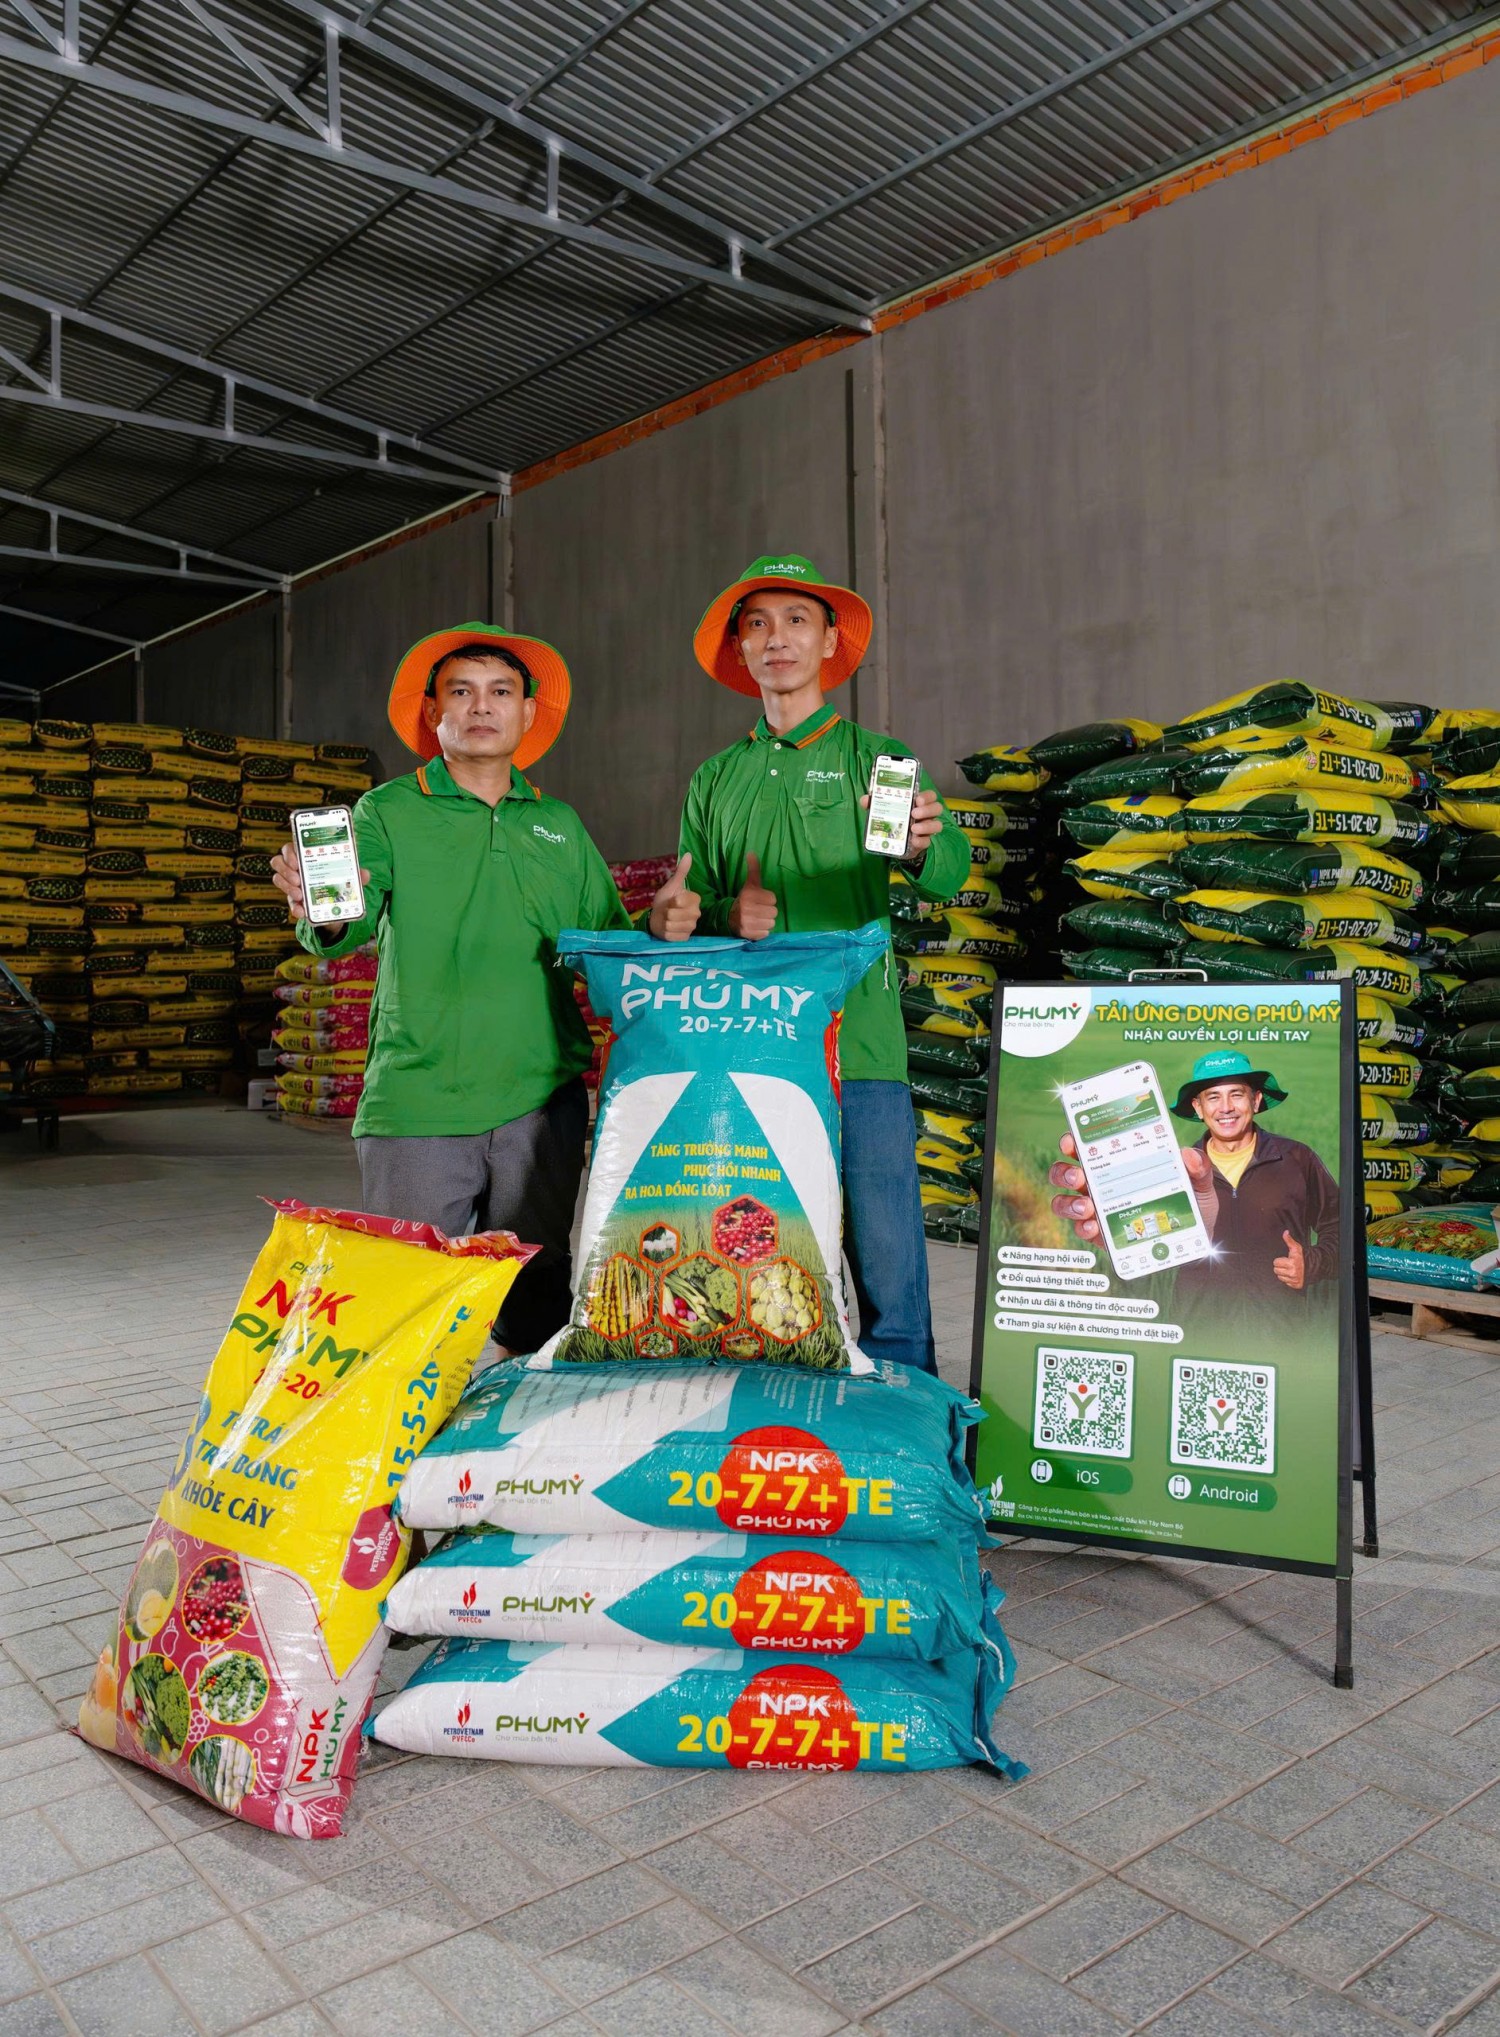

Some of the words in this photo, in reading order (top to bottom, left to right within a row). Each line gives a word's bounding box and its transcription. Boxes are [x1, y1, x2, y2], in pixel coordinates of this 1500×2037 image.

[764, 563, 806, 574] PHUMY
[807, 770, 846, 780] PHUMY
[1321, 753, 1381, 781] 20-20-15+TE
[1315, 812, 1379, 834] 20-20-15+TE
[533, 825, 566, 843] PHUMY
[1405, 829, 1418, 840] NPK
[1317, 919, 1379, 939] 20-20-15+TE
[621, 963, 744, 987] NPK
[621, 983, 731, 1019] PHÚ
[741, 984, 815, 1017] MỸ
[1004, 1003, 1082, 1020] PHUMY
[1095, 999, 1127, 1022] TẢI
[1133, 1000, 1180, 1022] ỨNG
[1186, 1005, 1249, 1026] DỤNG
[1256, 1000, 1303, 1022] PHÚ
[1309, 1001, 1342, 1022] MỸ
[679, 1015, 798, 1041] 20-7-7+TE
[1124, 1027, 1163, 1043] NHẬN
[1167, 1026, 1215, 1042] QUYỀN
[1219, 1029, 1243, 1044] LỢI
[1247, 1026, 1279, 1041] LIỀN
[1284, 1030, 1310, 1041] TAY
[1205, 1057, 1235, 1067] PHUMY
[1360, 1065, 1409, 1085] 0-20-15+TE
[651, 1142, 680, 1157] TĂNG
[734, 1144, 768, 1160] MẠNH
[717, 1162, 738, 1177] HỒI
[741, 1167, 781, 1182] NHANH
[625, 1187, 637, 1199] RA
[640, 1184, 663, 1197] HOA
[665, 1180, 699, 1196] ĐỒNG
[1009, 1251, 1032, 1262] Nâng
[1033, 1253, 1055, 1265] hạng
[1056, 1254, 1071, 1264] hội
[1072, 1256, 1090, 1264] viên
[1008, 1272, 1023, 1282] Đổi
[1025, 1276, 1041, 1285] quà
[1043, 1276, 1063, 1287] tặng
[1064, 1277, 1084, 1287] thiết
[1085, 1279, 1105, 1291] thực
[1007, 1296, 1029, 1307] Nhận
[1044, 1298, 1057, 1307] đãi
[1058, 1299, 1065, 1307] &
[1067, 1300, 1093, 1311] thông
[1094, 1302, 1106, 1310] tin
[1108, 1303, 1125, 1313] độc
[1127, 1304, 1154, 1316] quyền
[1006, 1318, 1030, 1328] Tham
[1031, 1321, 1045, 1330] gia
[1046, 1322, 1057, 1332] sự
[1058, 1322, 1077, 1333] kiện
[1087, 1325, 1119, 1336] chương
[1121, 1326, 1142, 1337] trình
[1161, 1329, 1179, 1341] biệt
[750, 1450, 819, 1474] NPK
[495, 1473, 584, 1495] PHUMY
[1076, 1469, 1100, 1485] iOS
[668, 1471, 893, 1515] 20-7-7+TE
[1199, 1484, 1258, 1504] Android
[181, 1480, 226, 1513] KHỎE
[228, 1498, 275, 1528] CÂY
[736, 1514, 792, 1529] PHÚ
[1018, 1504, 1033, 1512] Công
[1149, 1520, 1159, 1529] Tây
[370, 1521, 392, 1573] PETROVIETNAM
[765, 1571, 835, 1594] NPK
[449, 1608, 491, 1617] PETROVIETNAM
[502, 1592, 597, 1614] PHUMY
[682, 1591, 912, 1635] 20-7-7+TE
[458, 1616, 482, 1624] PVFCCo
[501, 1615, 517, 1623] Cho
[751, 1635, 808, 1649] PHÚ
[759, 1692, 831, 1717] NPK
[443, 1727, 484, 1736] PETROVIETNAM
[496, 1712, 591, 1734] PHUMY
[296, 1708, 328, 1782] NPK
[677, 1715, 906, 1762] 20-7-7+TE
[320, 1738, 338, 1778] HÚ
